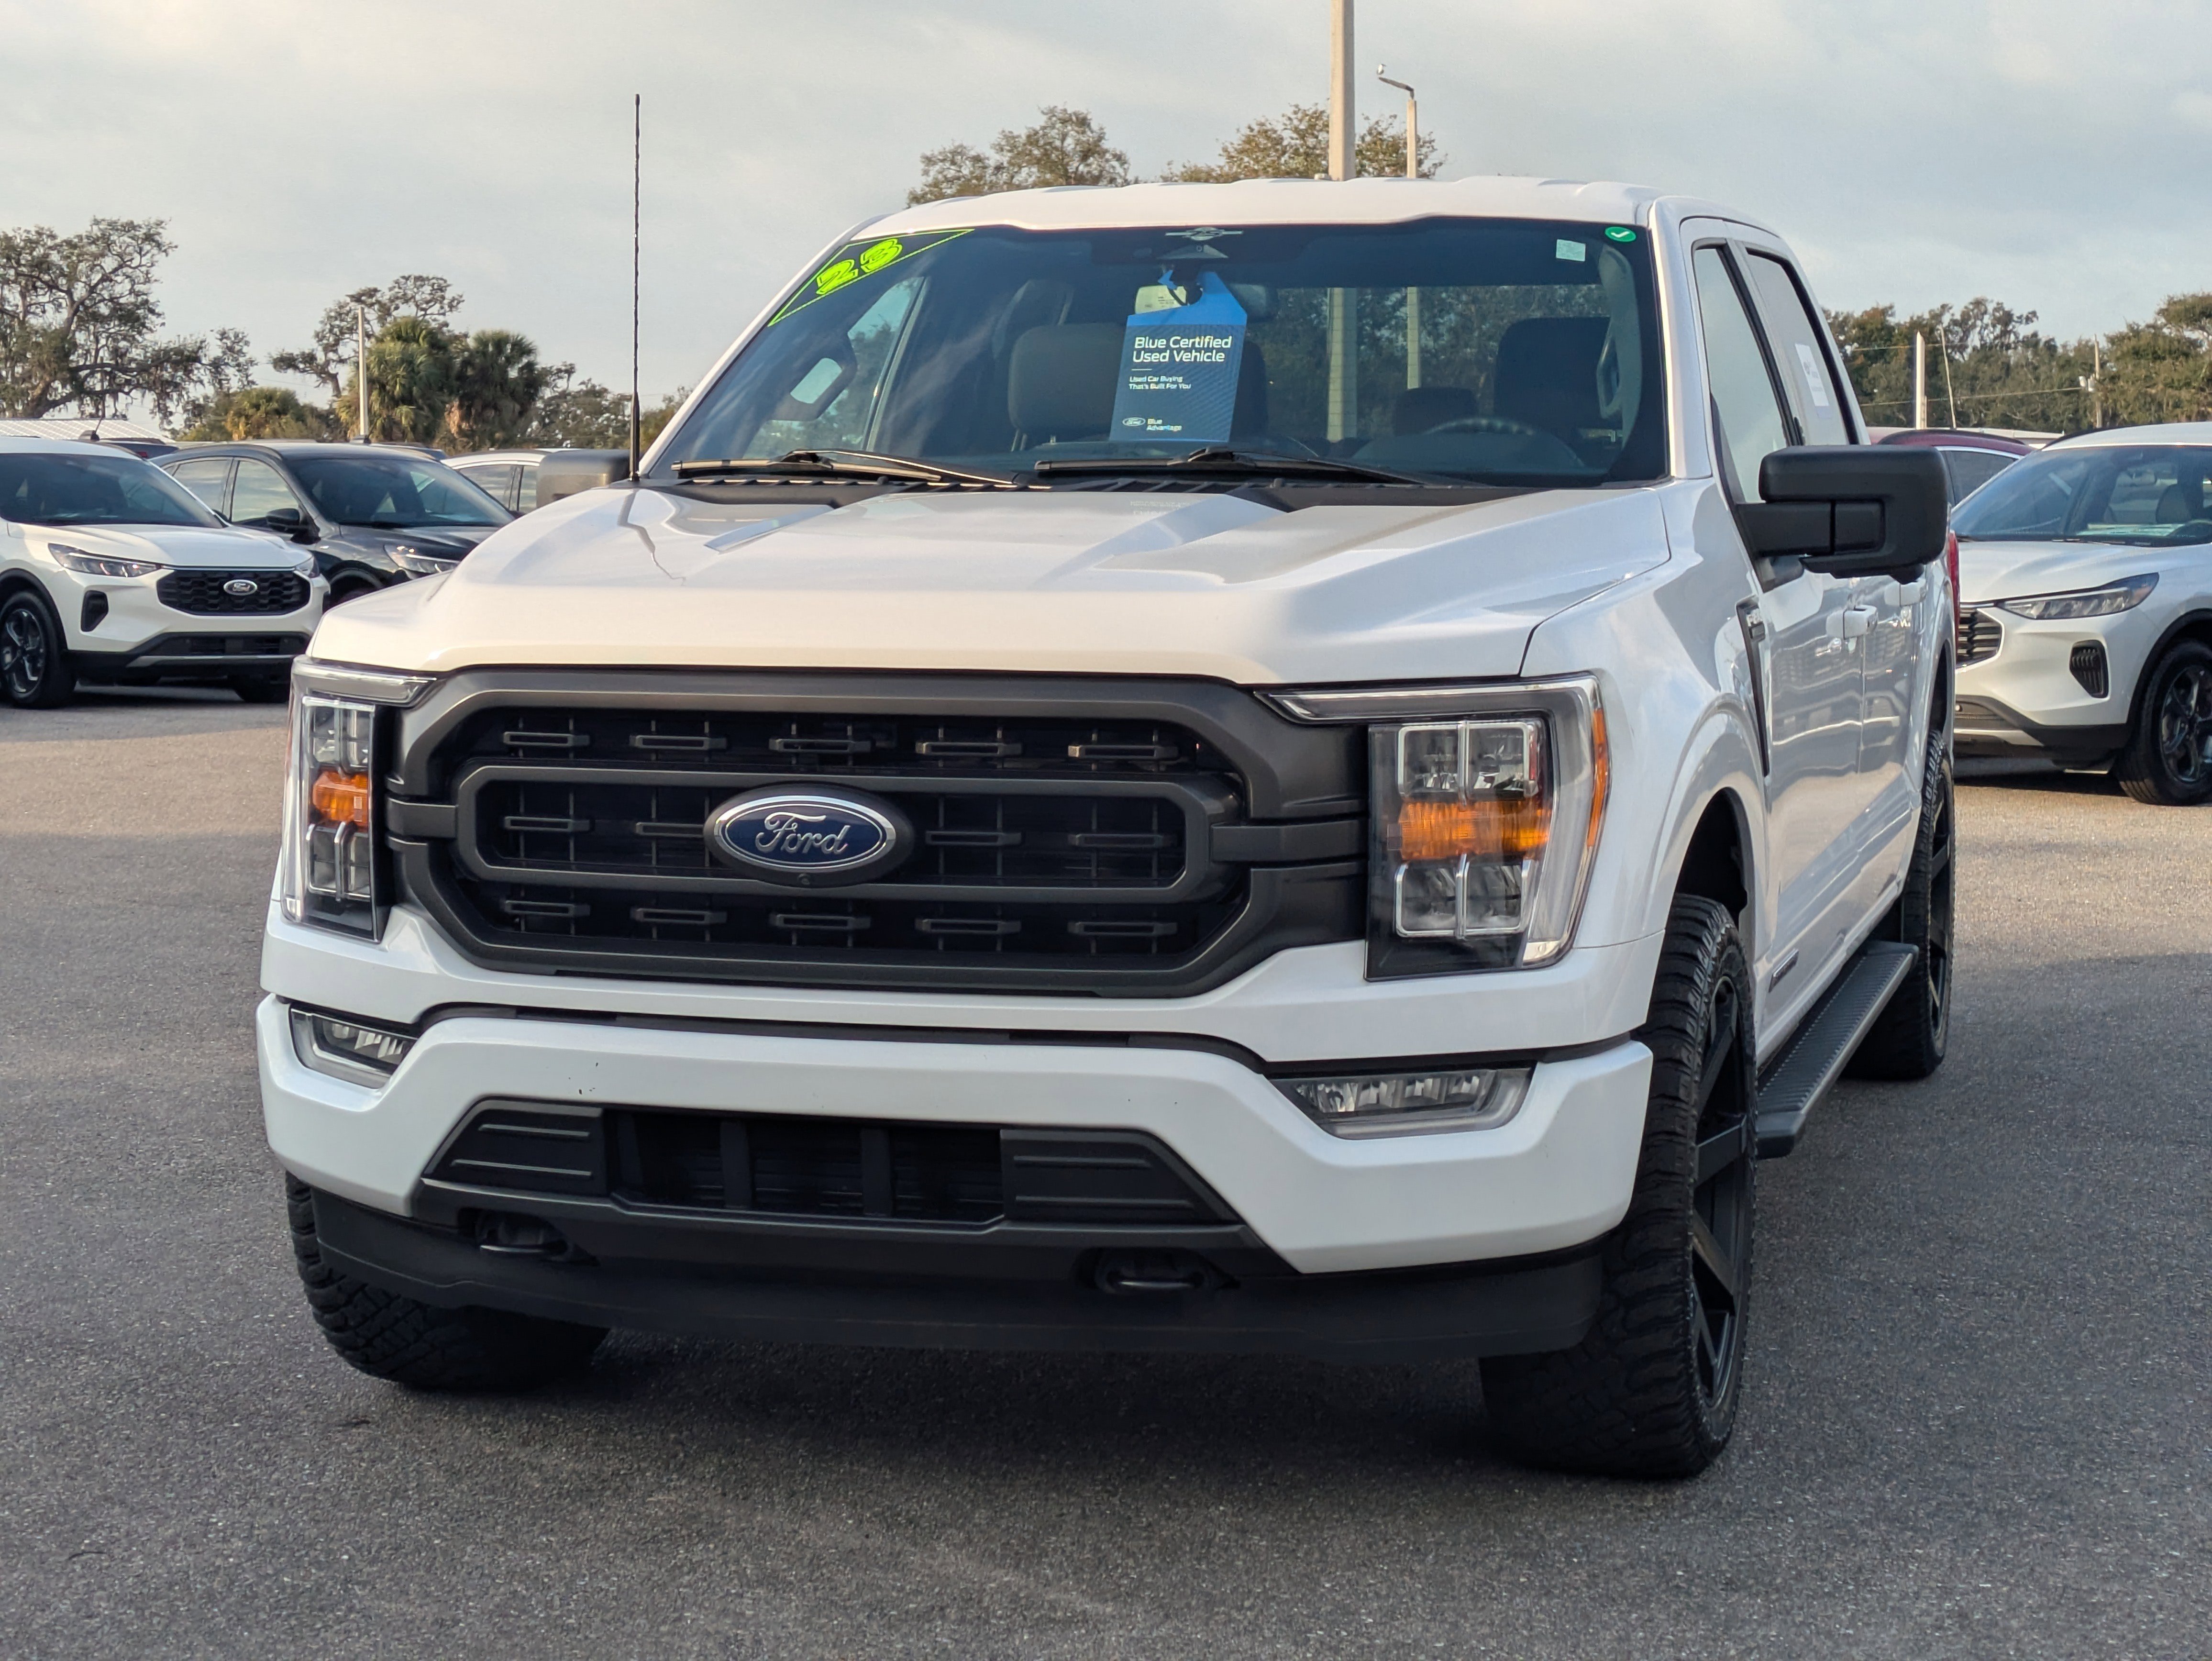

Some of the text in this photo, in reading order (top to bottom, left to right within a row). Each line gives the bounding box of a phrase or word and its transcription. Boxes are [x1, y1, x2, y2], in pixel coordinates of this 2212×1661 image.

[816, 239, 903, 295] 23
[1133, 349, 1225, 363] Used Vehicle
[1134, 336, 1232, 349] Blue Certified
[755, 812, 851, 855] Ford
